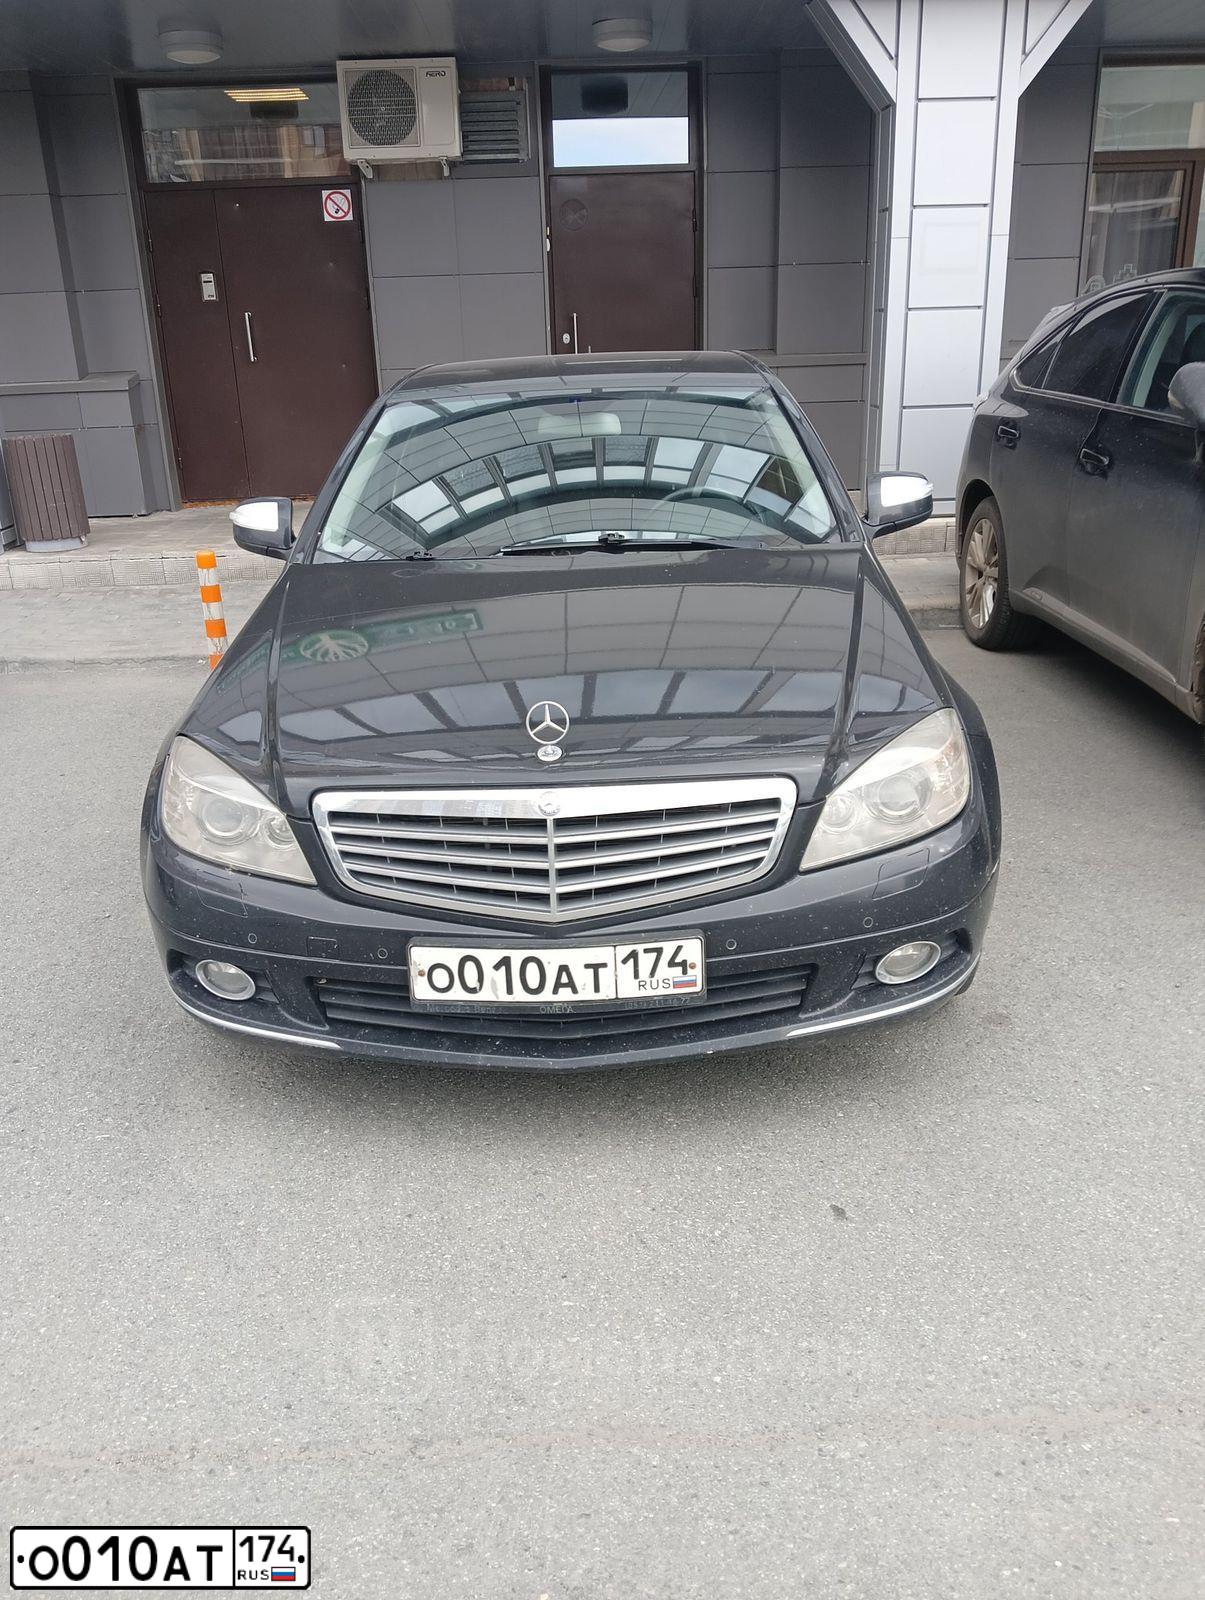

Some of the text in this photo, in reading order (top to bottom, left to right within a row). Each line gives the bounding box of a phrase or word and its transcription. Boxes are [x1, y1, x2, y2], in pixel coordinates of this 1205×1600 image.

[425, 70, 447, 78] AERO
[621, 944, 689, 980] 174
[637, 978, 671, 991] RUS
